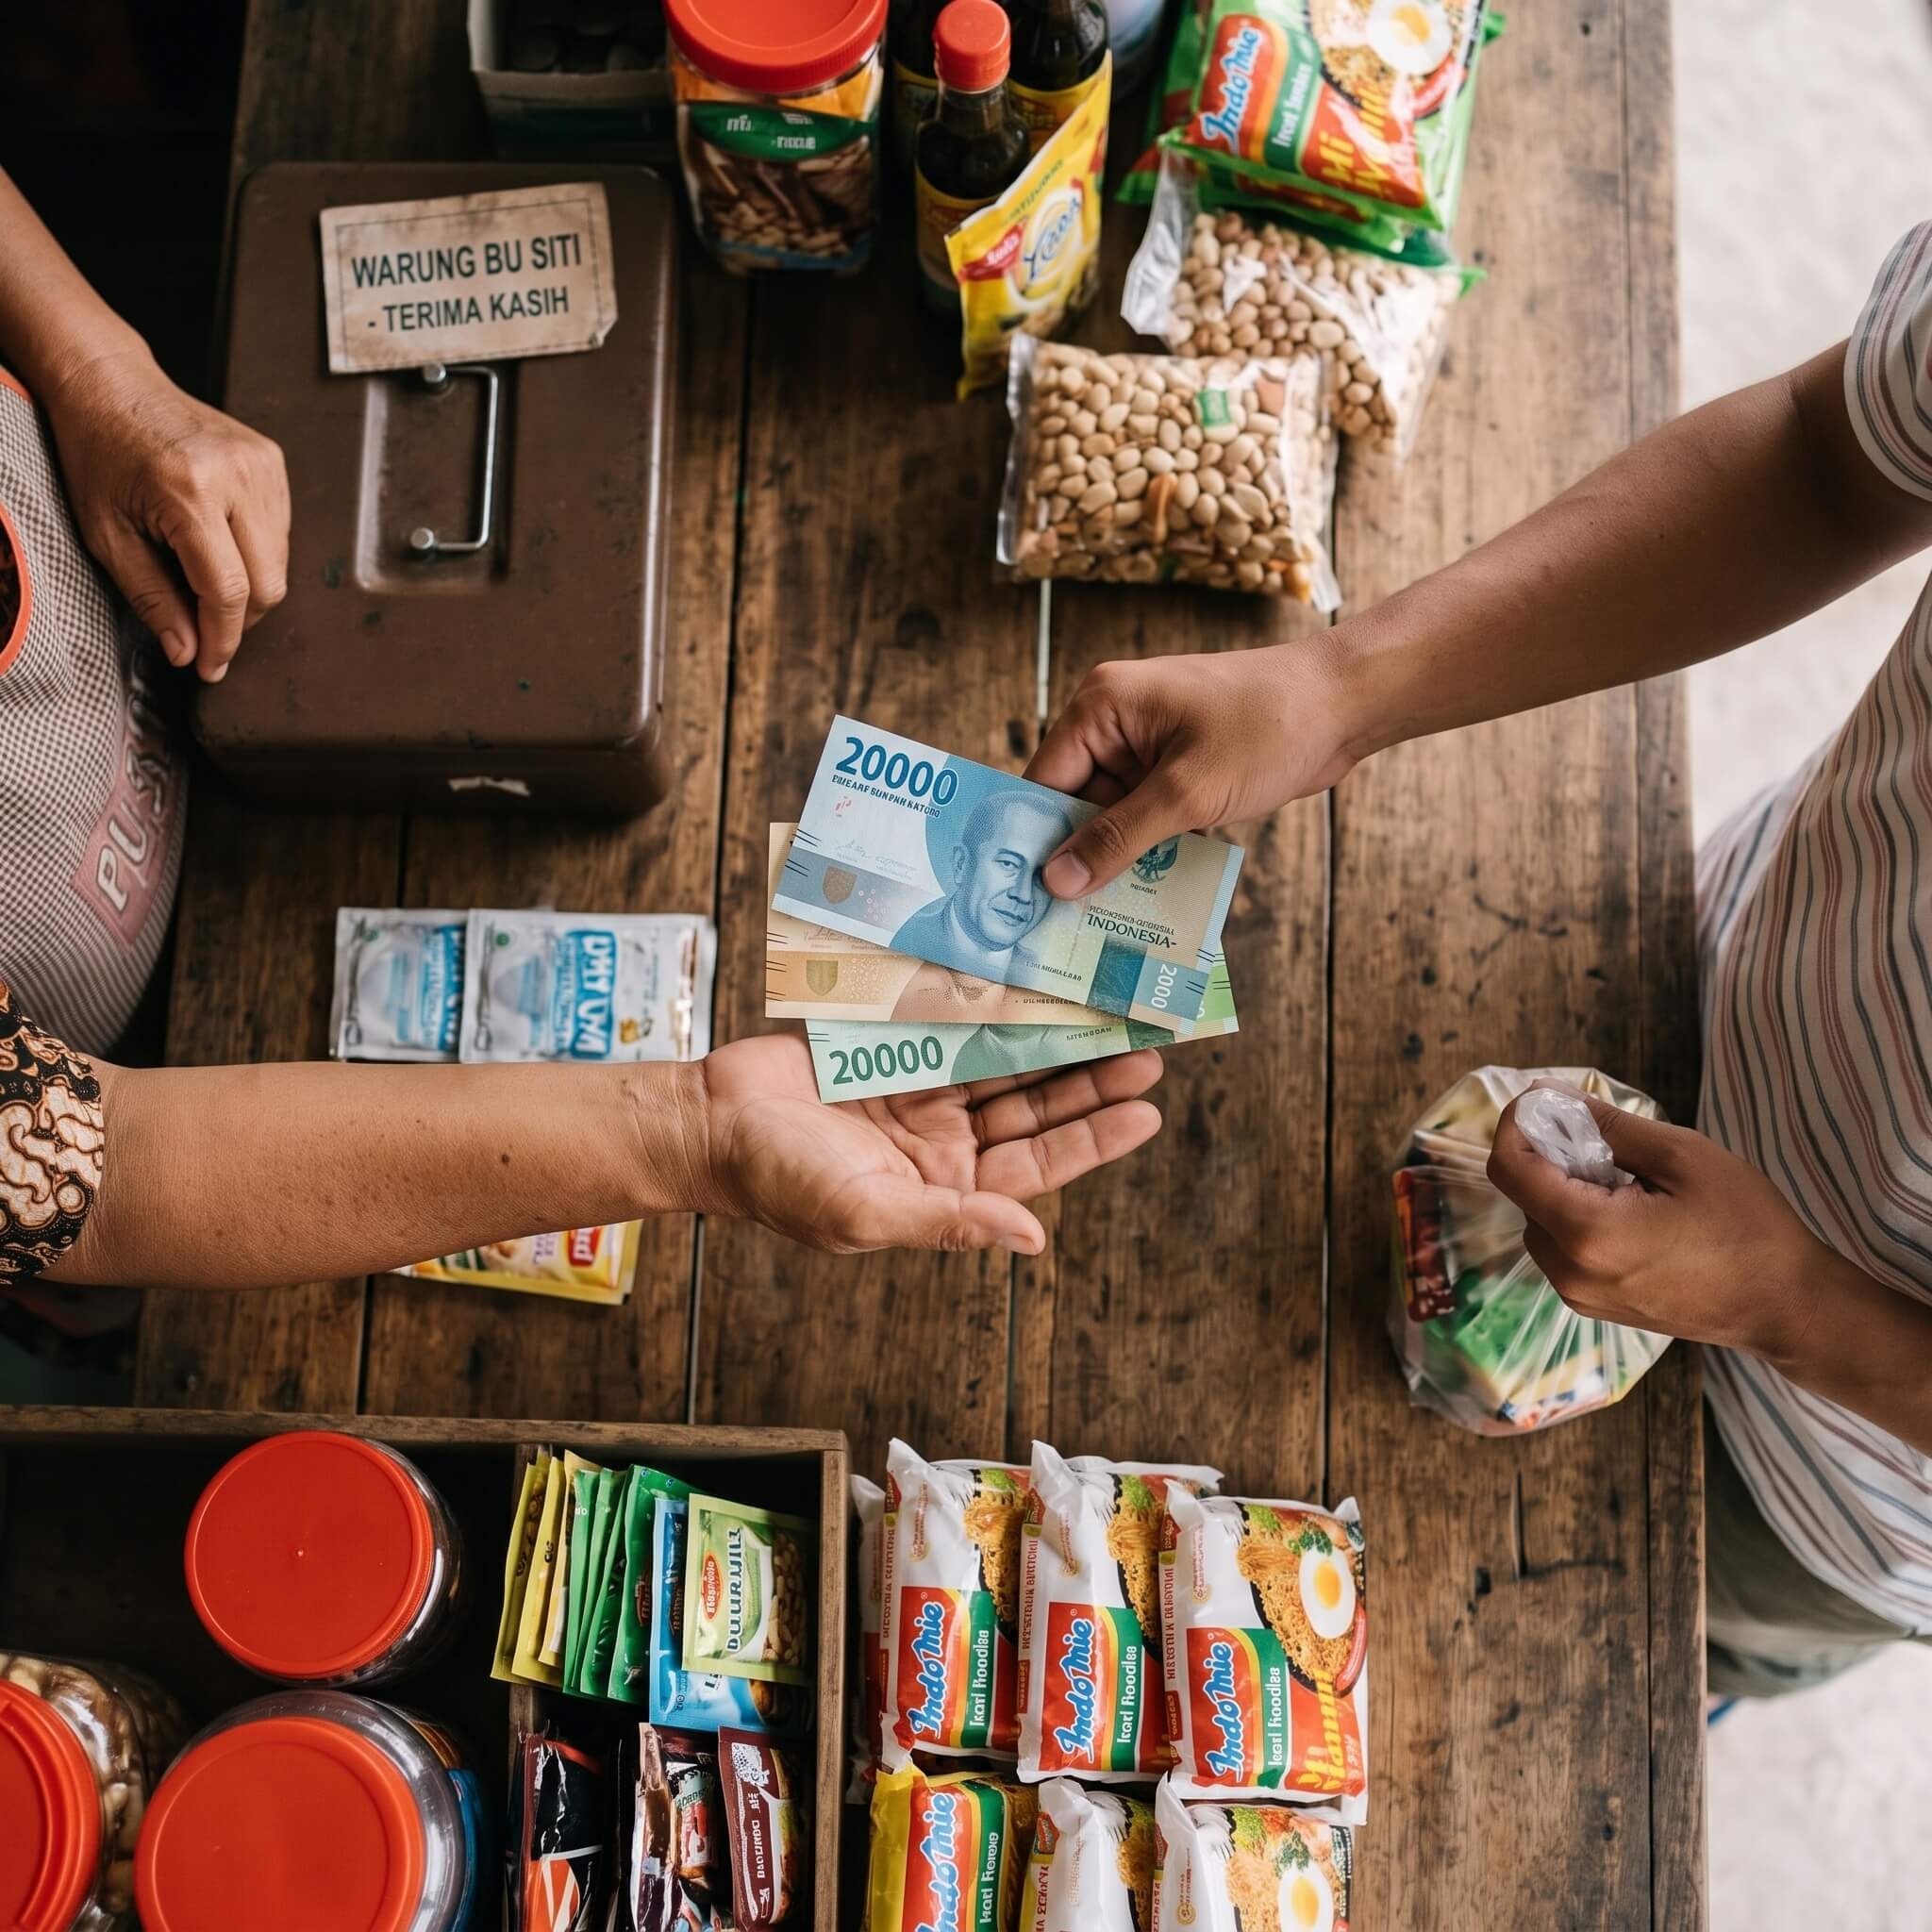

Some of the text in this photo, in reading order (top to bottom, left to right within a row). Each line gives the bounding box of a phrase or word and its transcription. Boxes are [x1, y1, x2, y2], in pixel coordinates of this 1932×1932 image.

[351, 233, 582, 289] WARUNG BU SITI
[382, 297, 483, 332] TERIMA
[490, 286, 570, 321] KASIH
[835, 736, 958, 807] 20000
[1151, 963, 1178, 1009] 2000
[829, 1036, 944, 1085] 20000
